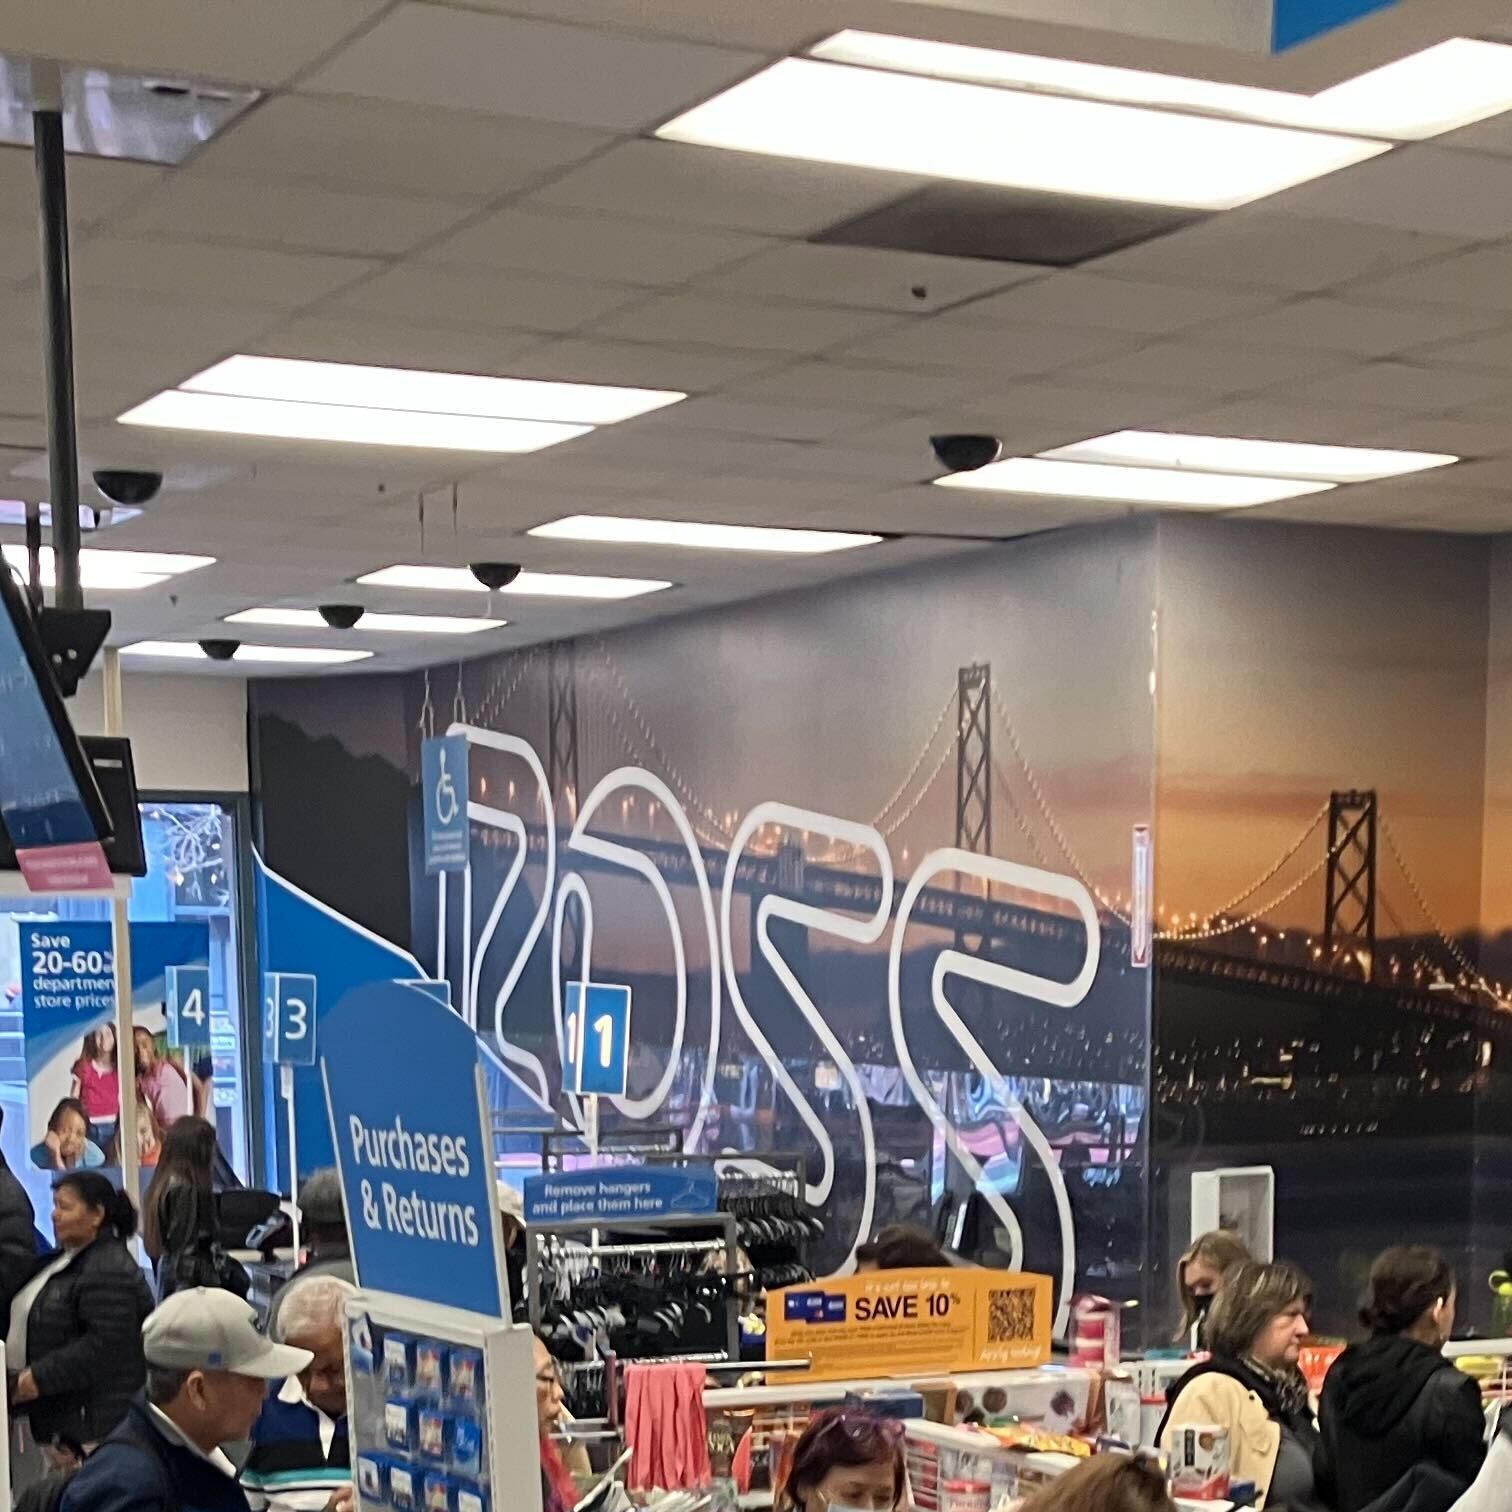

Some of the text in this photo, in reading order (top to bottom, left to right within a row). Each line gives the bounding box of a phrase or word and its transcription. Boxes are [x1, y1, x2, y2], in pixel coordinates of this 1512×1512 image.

[31, 933, 71, 948] Save
[33, 976, 114, 992] departmen
[34, 993, 114, 1011] store price
[182, 988, 205, 1027] 4
[285, 998, 306, 1040] 3
[593, 1015, 613, 1068] 1
[349, 1113, 470, 1178] Purchases
[544, 1181, 651, 1198] Remove hangers
[361, 1178, 479, 1247] & Returns
[532, 1196, 663, 1216] and place them here
[855, 1295, 918, 1321] SAVE
